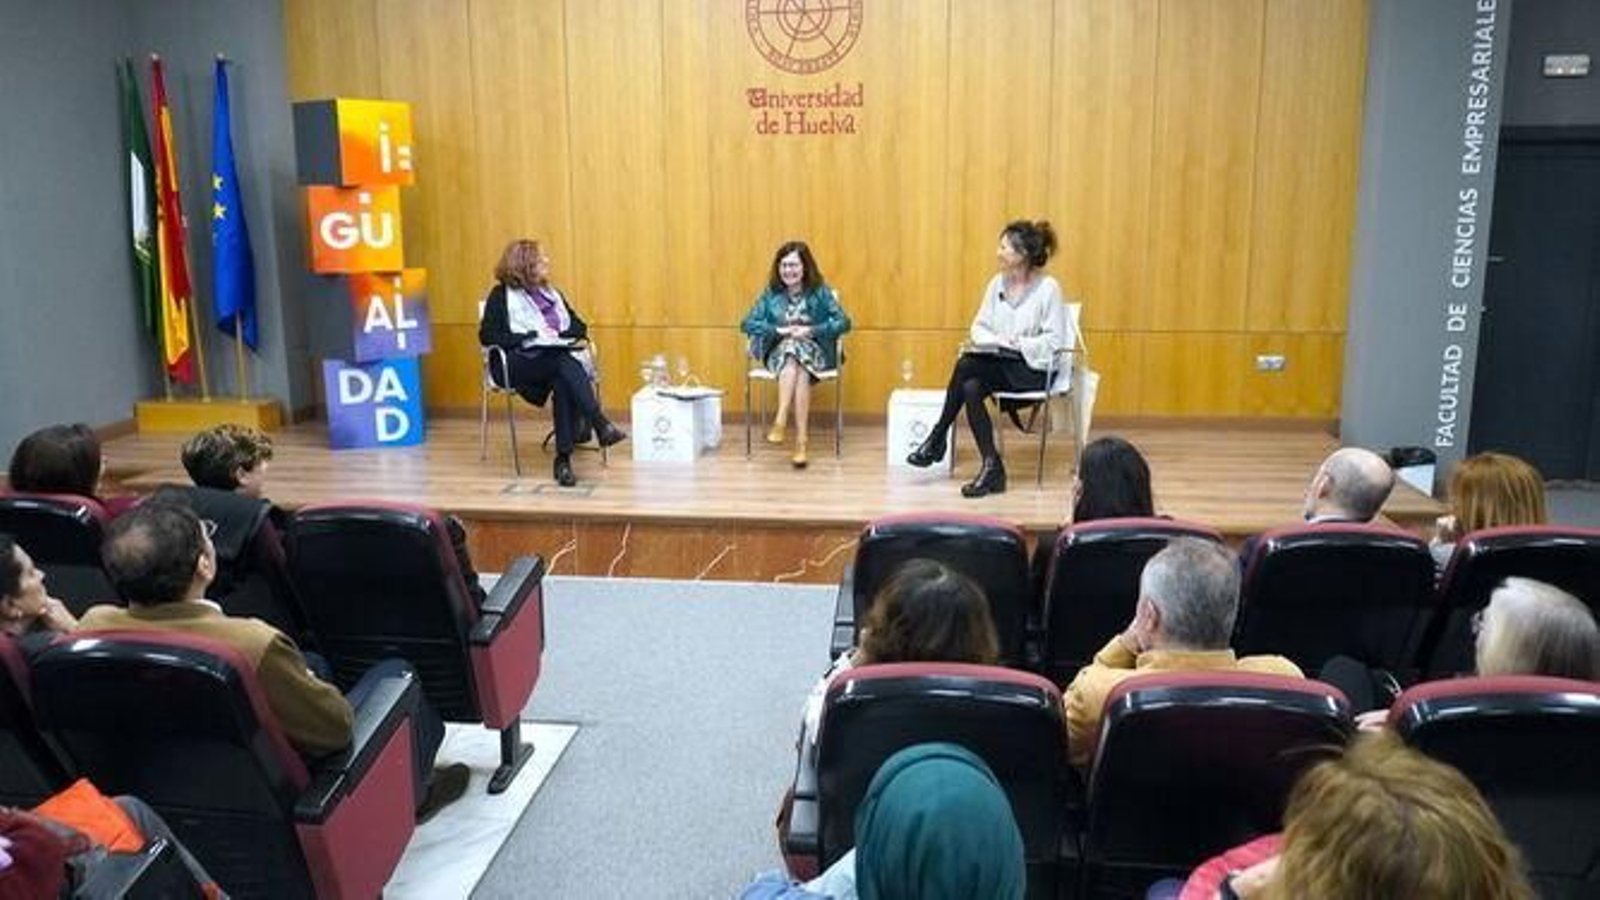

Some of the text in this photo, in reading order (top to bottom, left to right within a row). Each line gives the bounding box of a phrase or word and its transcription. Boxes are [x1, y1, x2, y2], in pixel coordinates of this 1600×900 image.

[746, 83, 864, 108] Universidad
[756, 111, 856, 134] de Huelva
[1452, 187, 1478, 288] CIENCIAS
[1447, 303, 1467, 332] DE
[338, 366, 408, 405] DA
[1436, 344, 1463, 447] FACULTAD
[375, 406, 410, 442] D
